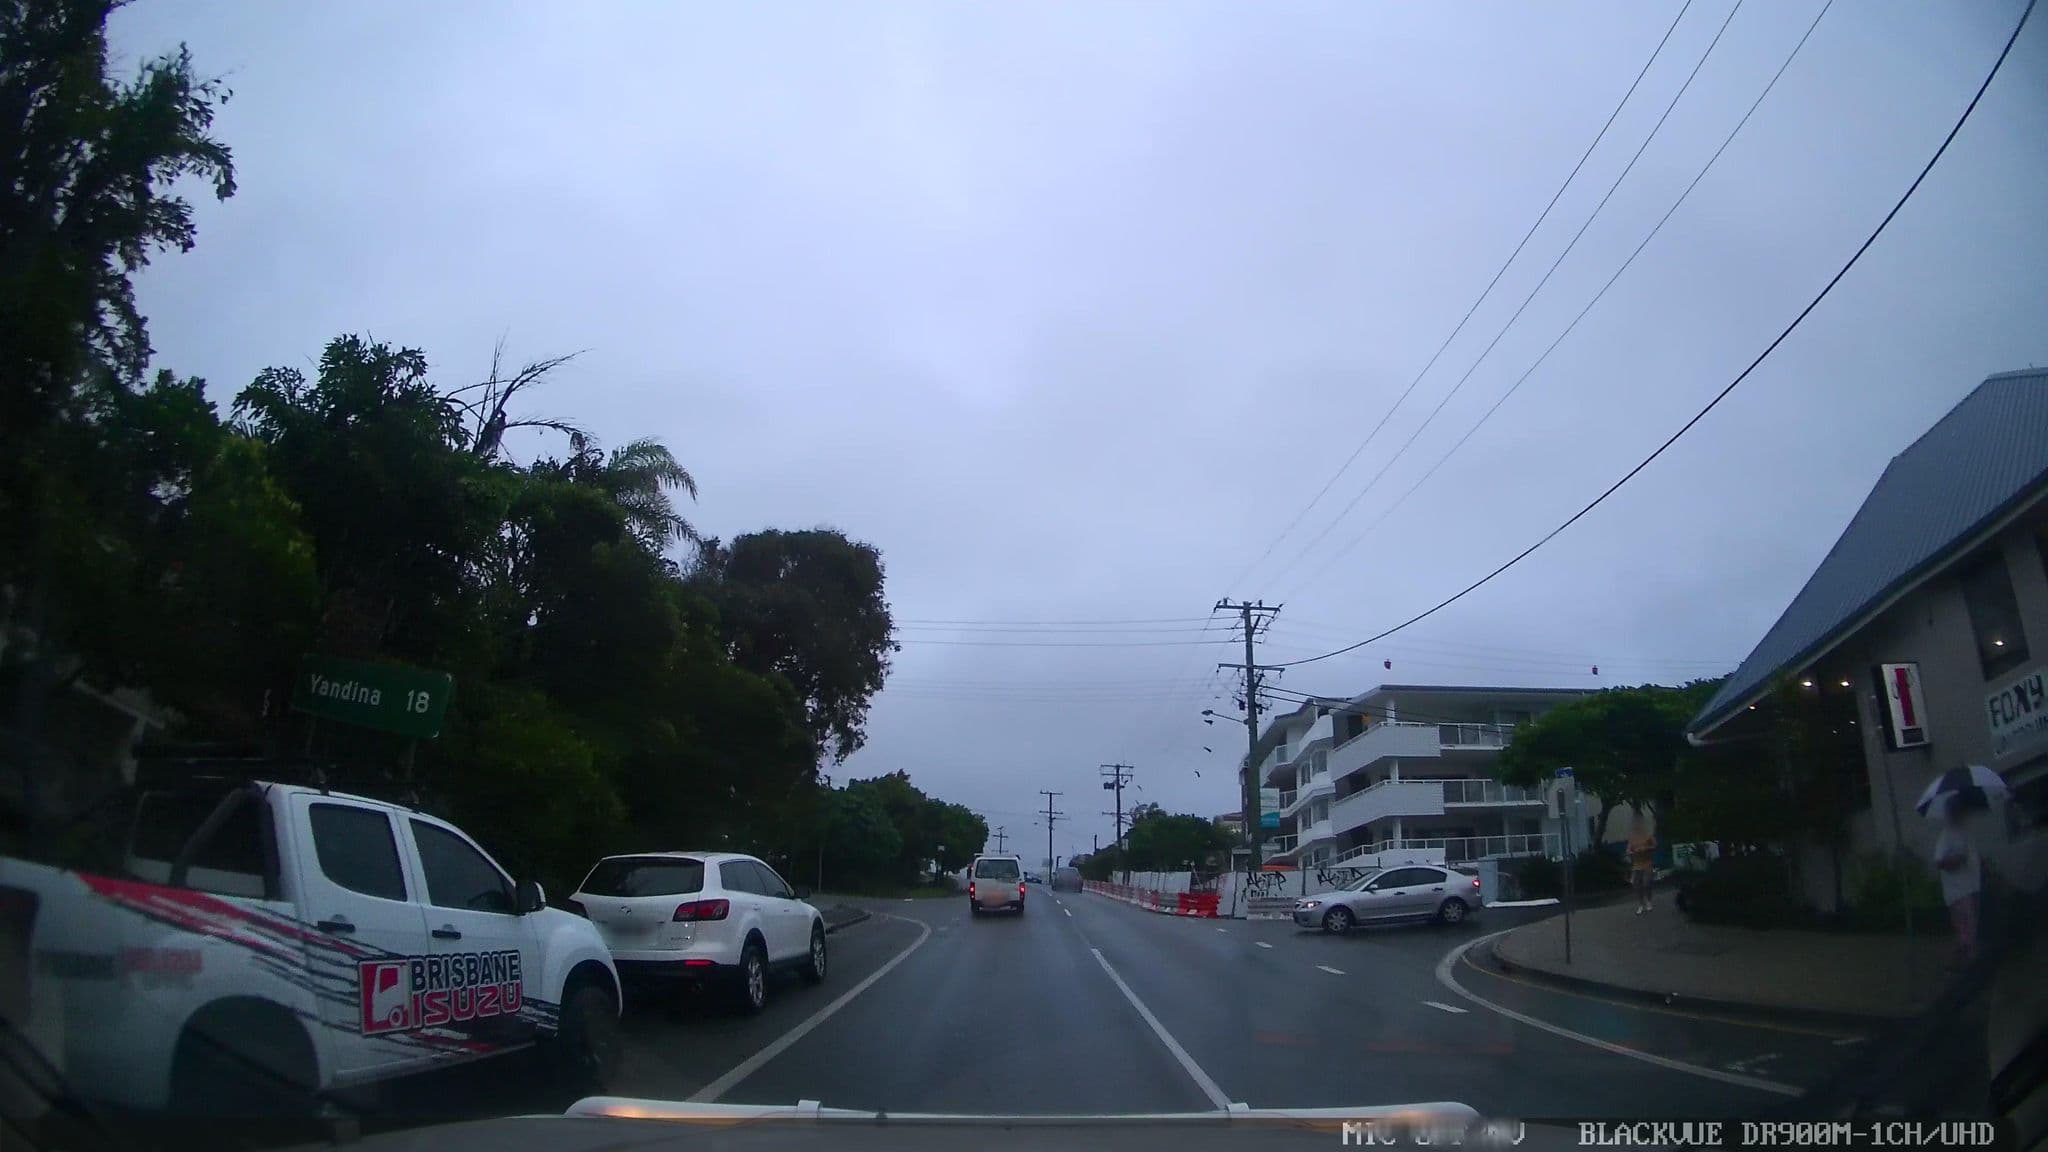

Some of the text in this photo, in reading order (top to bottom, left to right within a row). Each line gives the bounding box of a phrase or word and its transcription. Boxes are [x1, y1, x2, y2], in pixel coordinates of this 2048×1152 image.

[310, 673, 431, 714] Yandina 18
[1989, 674, 2044, 727] FOXY
[410, 951, 522, 992] BRISBANE
[410, 981, 523, 1029] ISUZU
